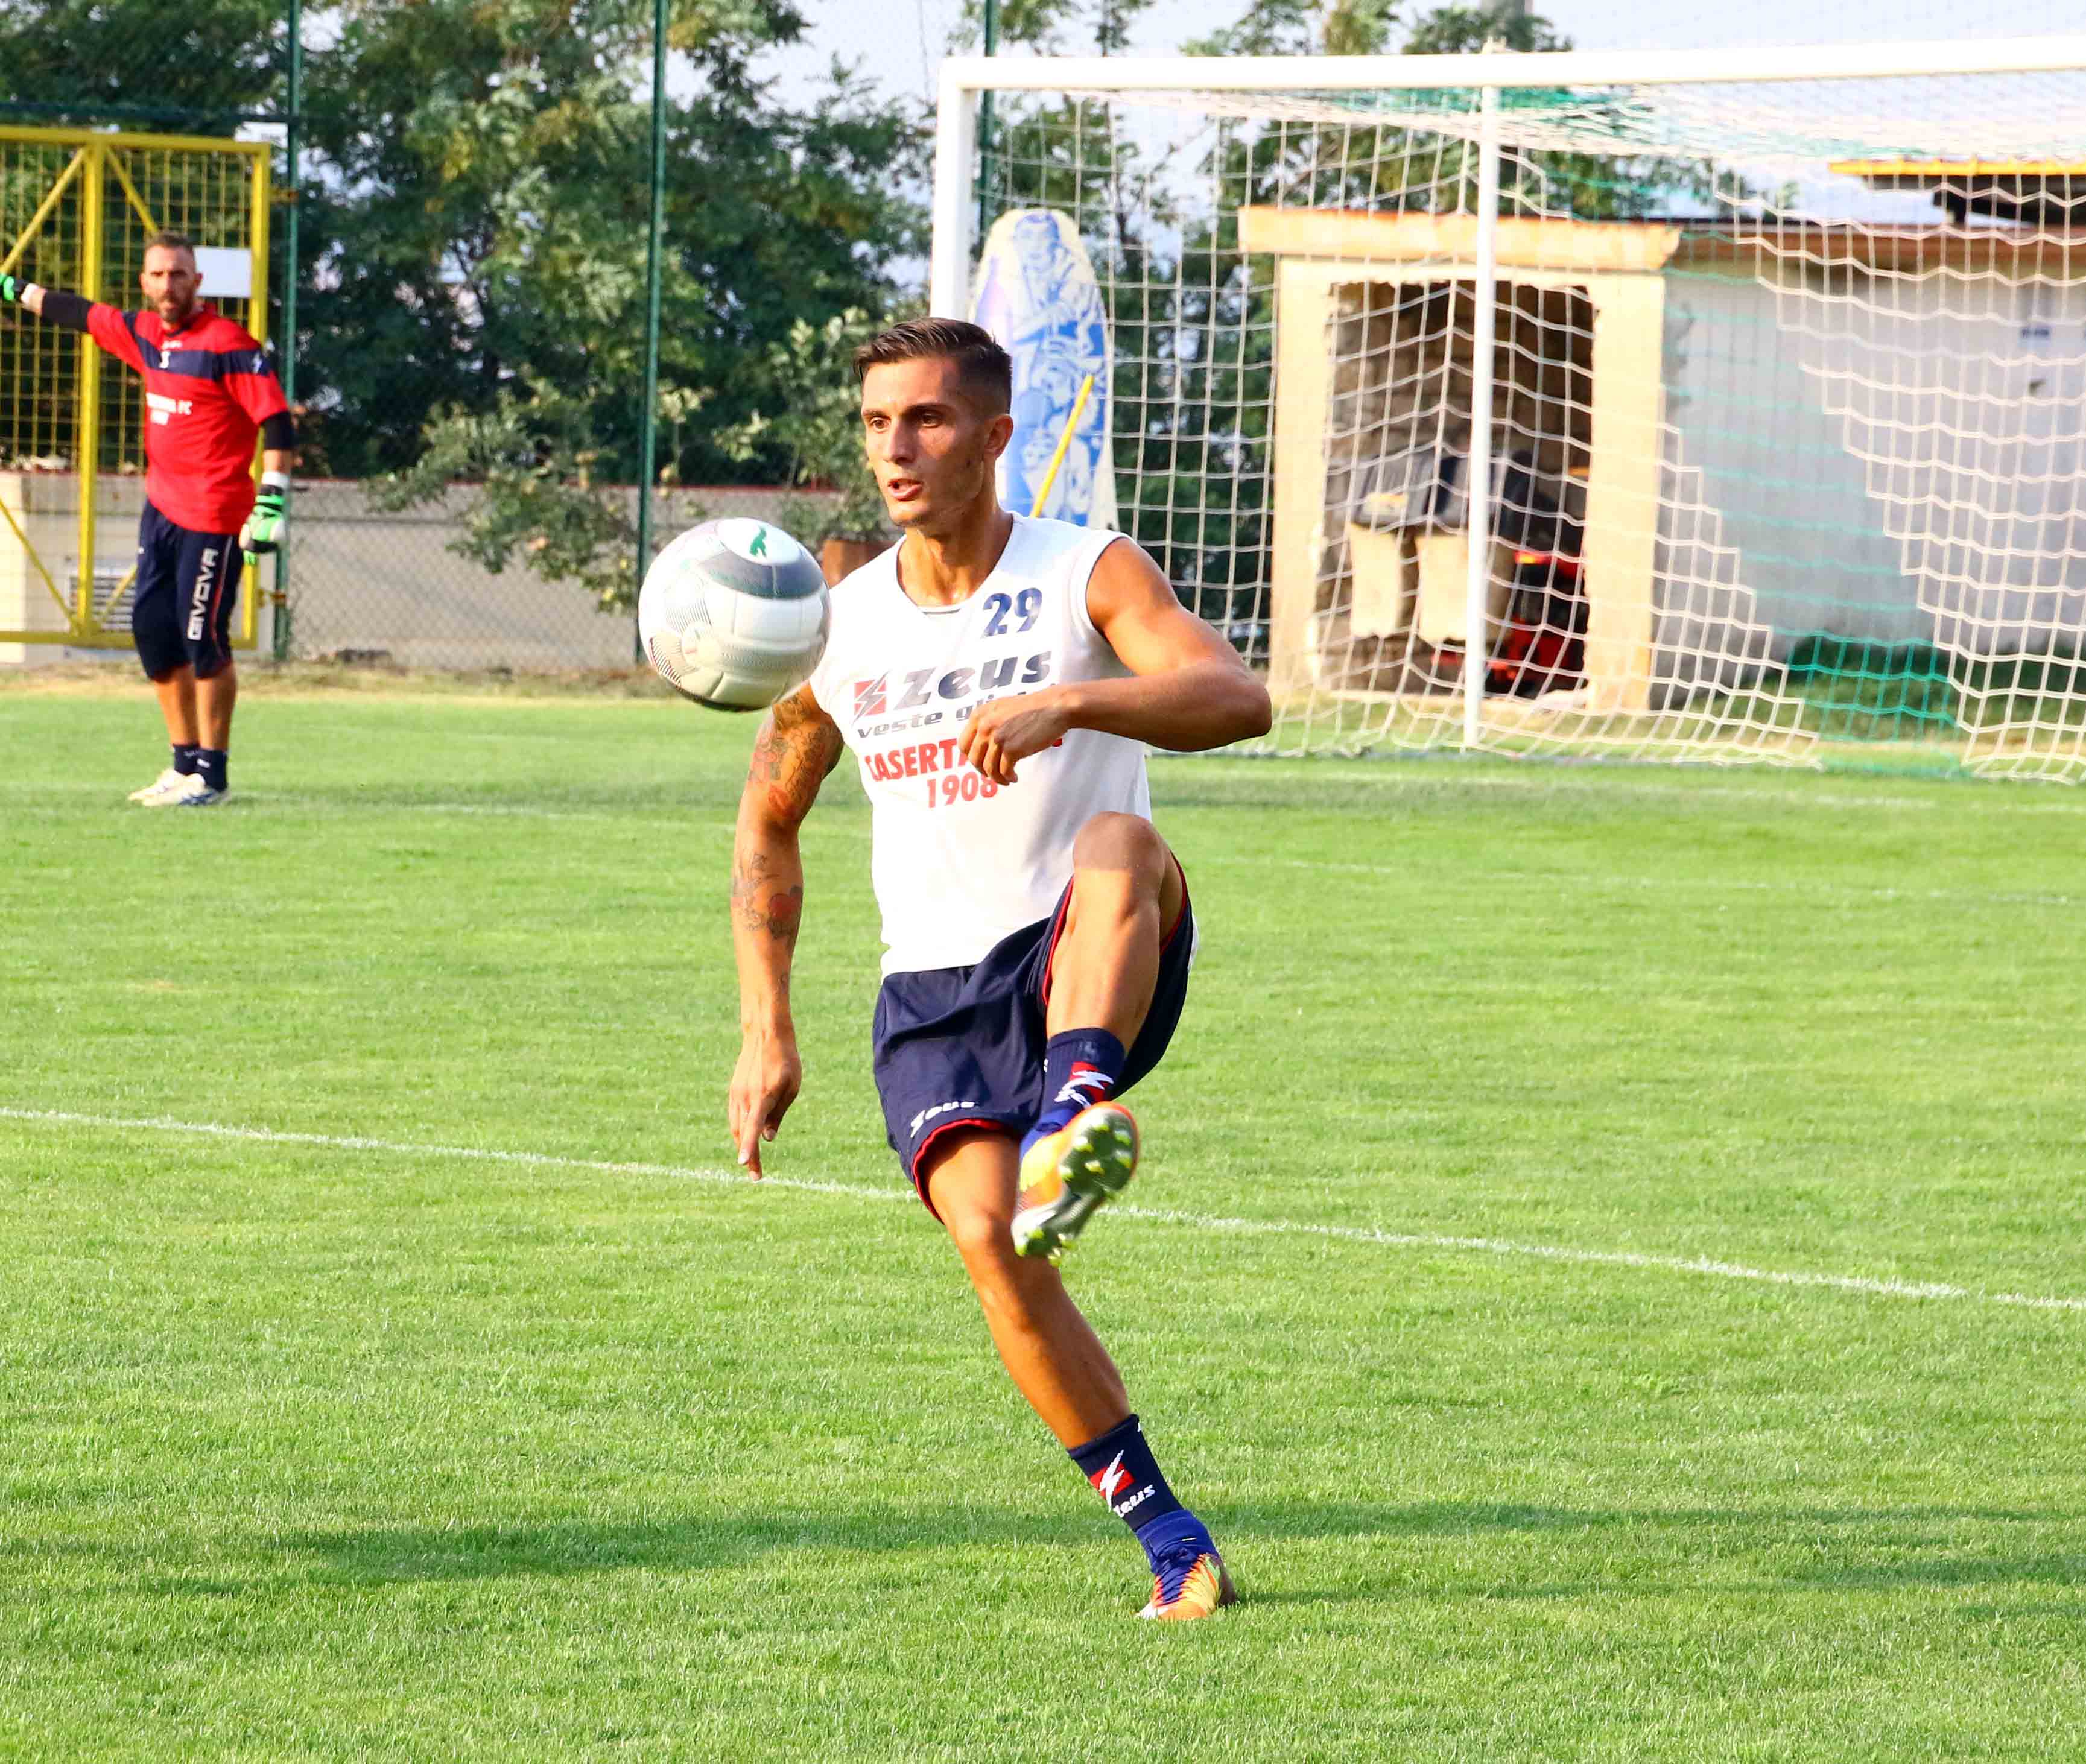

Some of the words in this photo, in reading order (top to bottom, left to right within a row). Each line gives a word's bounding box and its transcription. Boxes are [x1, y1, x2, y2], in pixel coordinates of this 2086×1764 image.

[187, 548, 219, 641] GIVOVA
[981, 587, 1042, 637] 29
[857, 712, 943, 739] veste
[864, 738, 968, 782] CASERT
[926, 772, 998, 808] 1908
